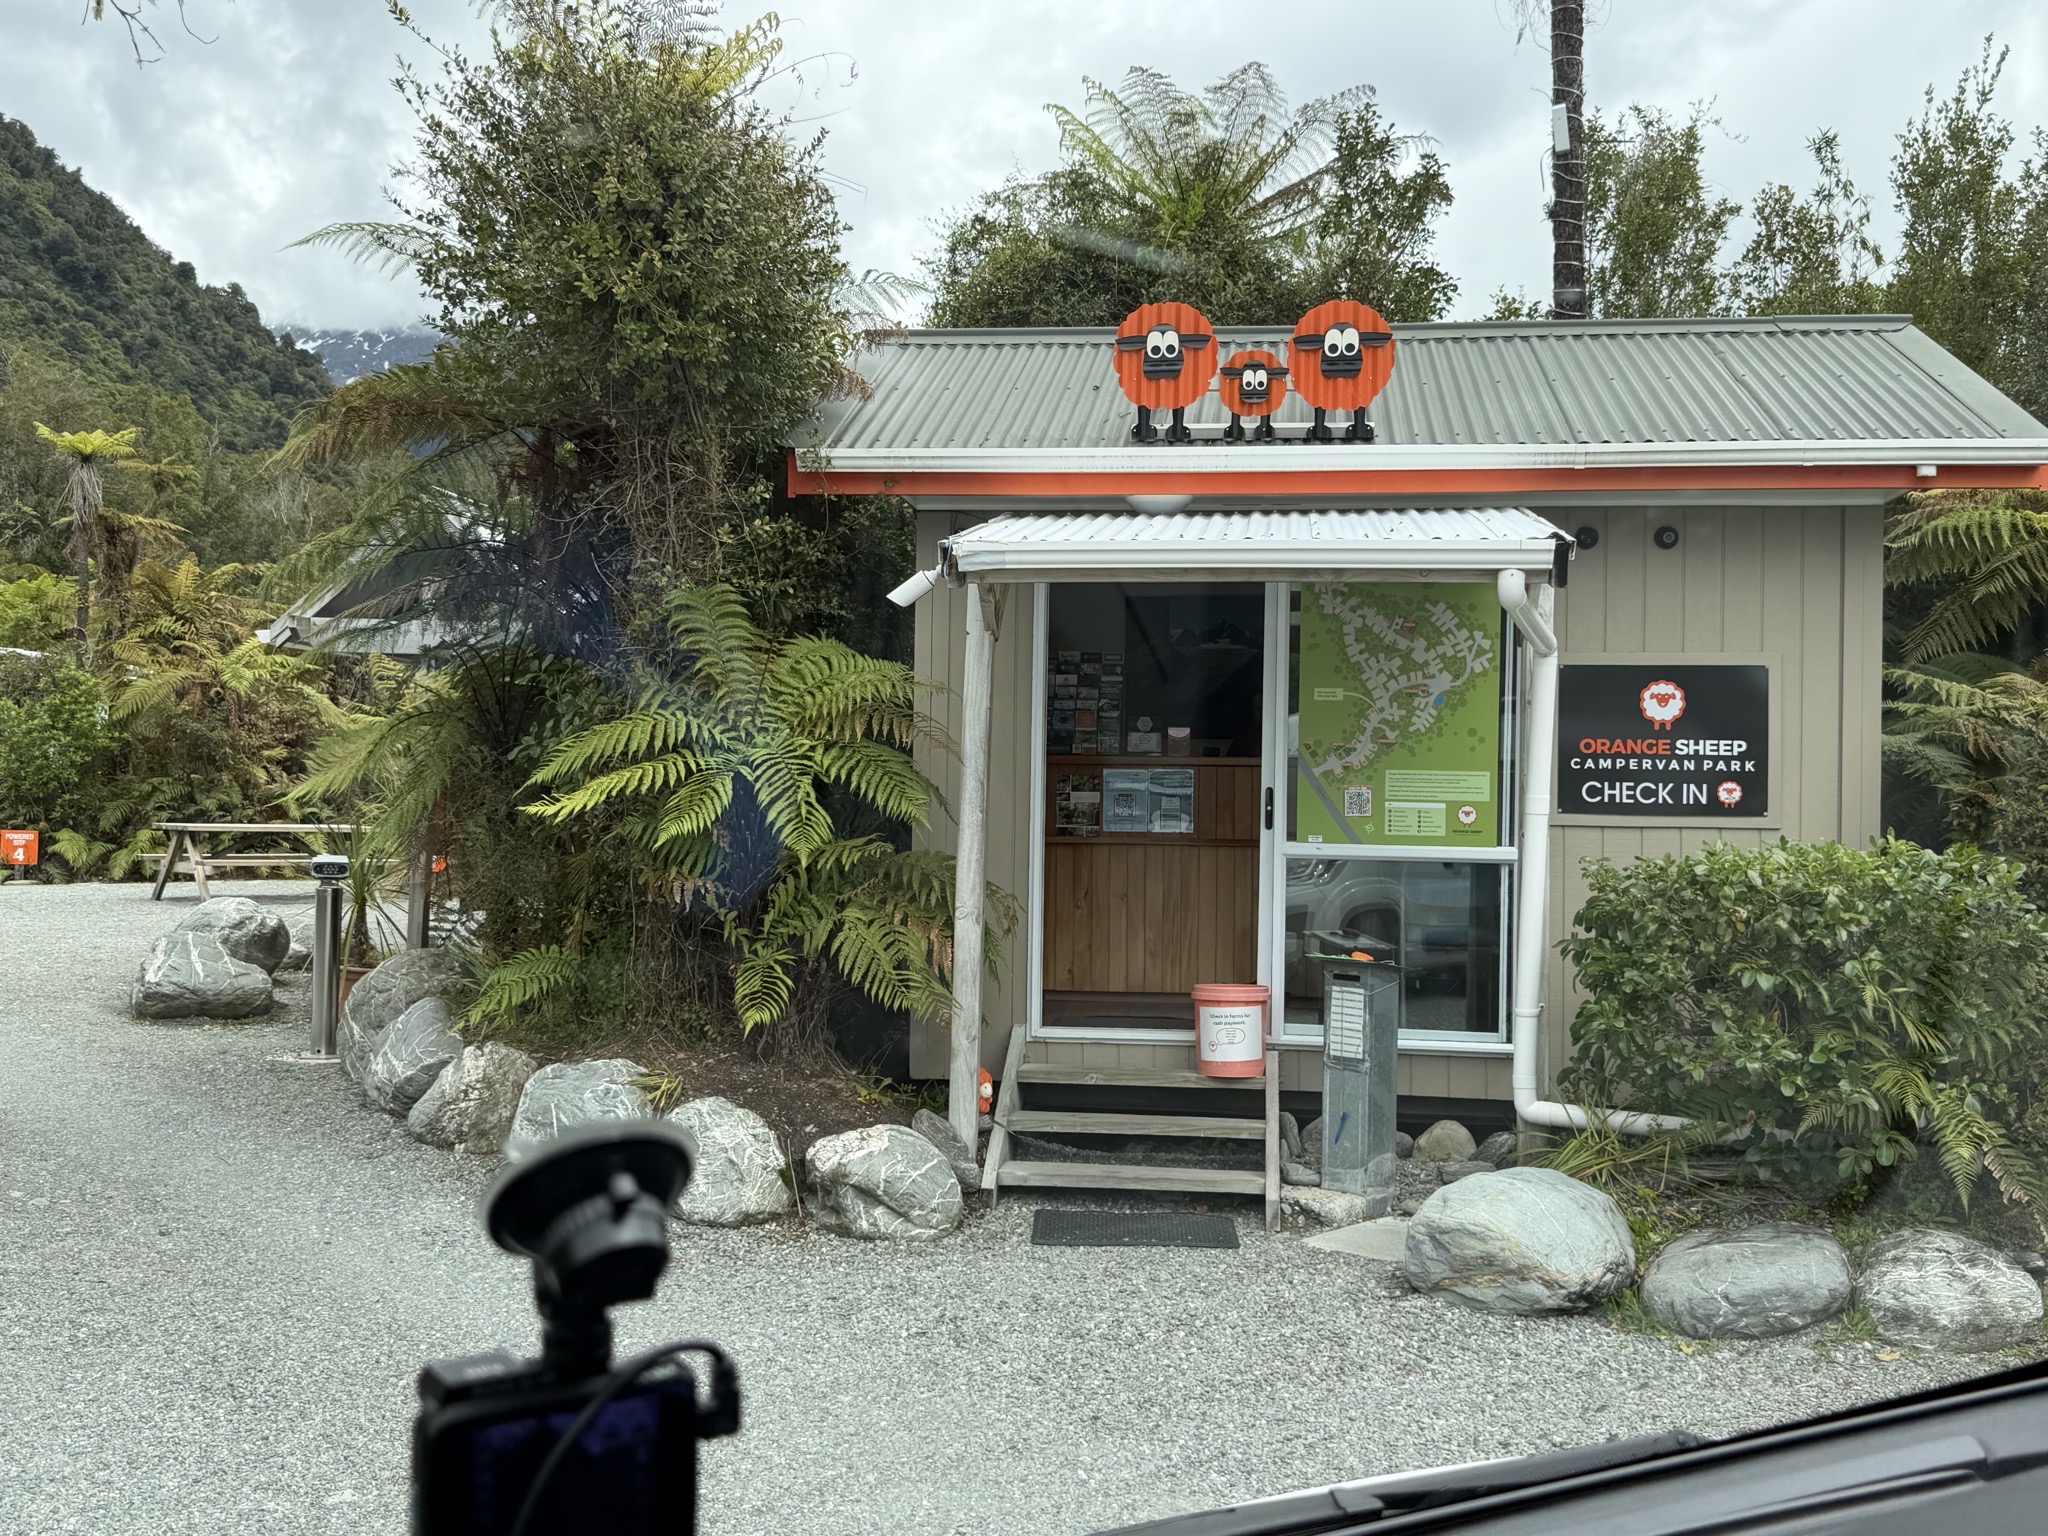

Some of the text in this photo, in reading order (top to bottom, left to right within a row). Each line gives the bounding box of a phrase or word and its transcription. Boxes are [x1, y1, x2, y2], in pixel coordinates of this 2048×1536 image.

[1579, 738, 1747, 756] ORANGE SHEEP
[1570, 758, 1756, 772] CAMPERVAN PARK
[1581, 781, 1708, 805] CHECK IN
[12, 847, 25, 862] 4
